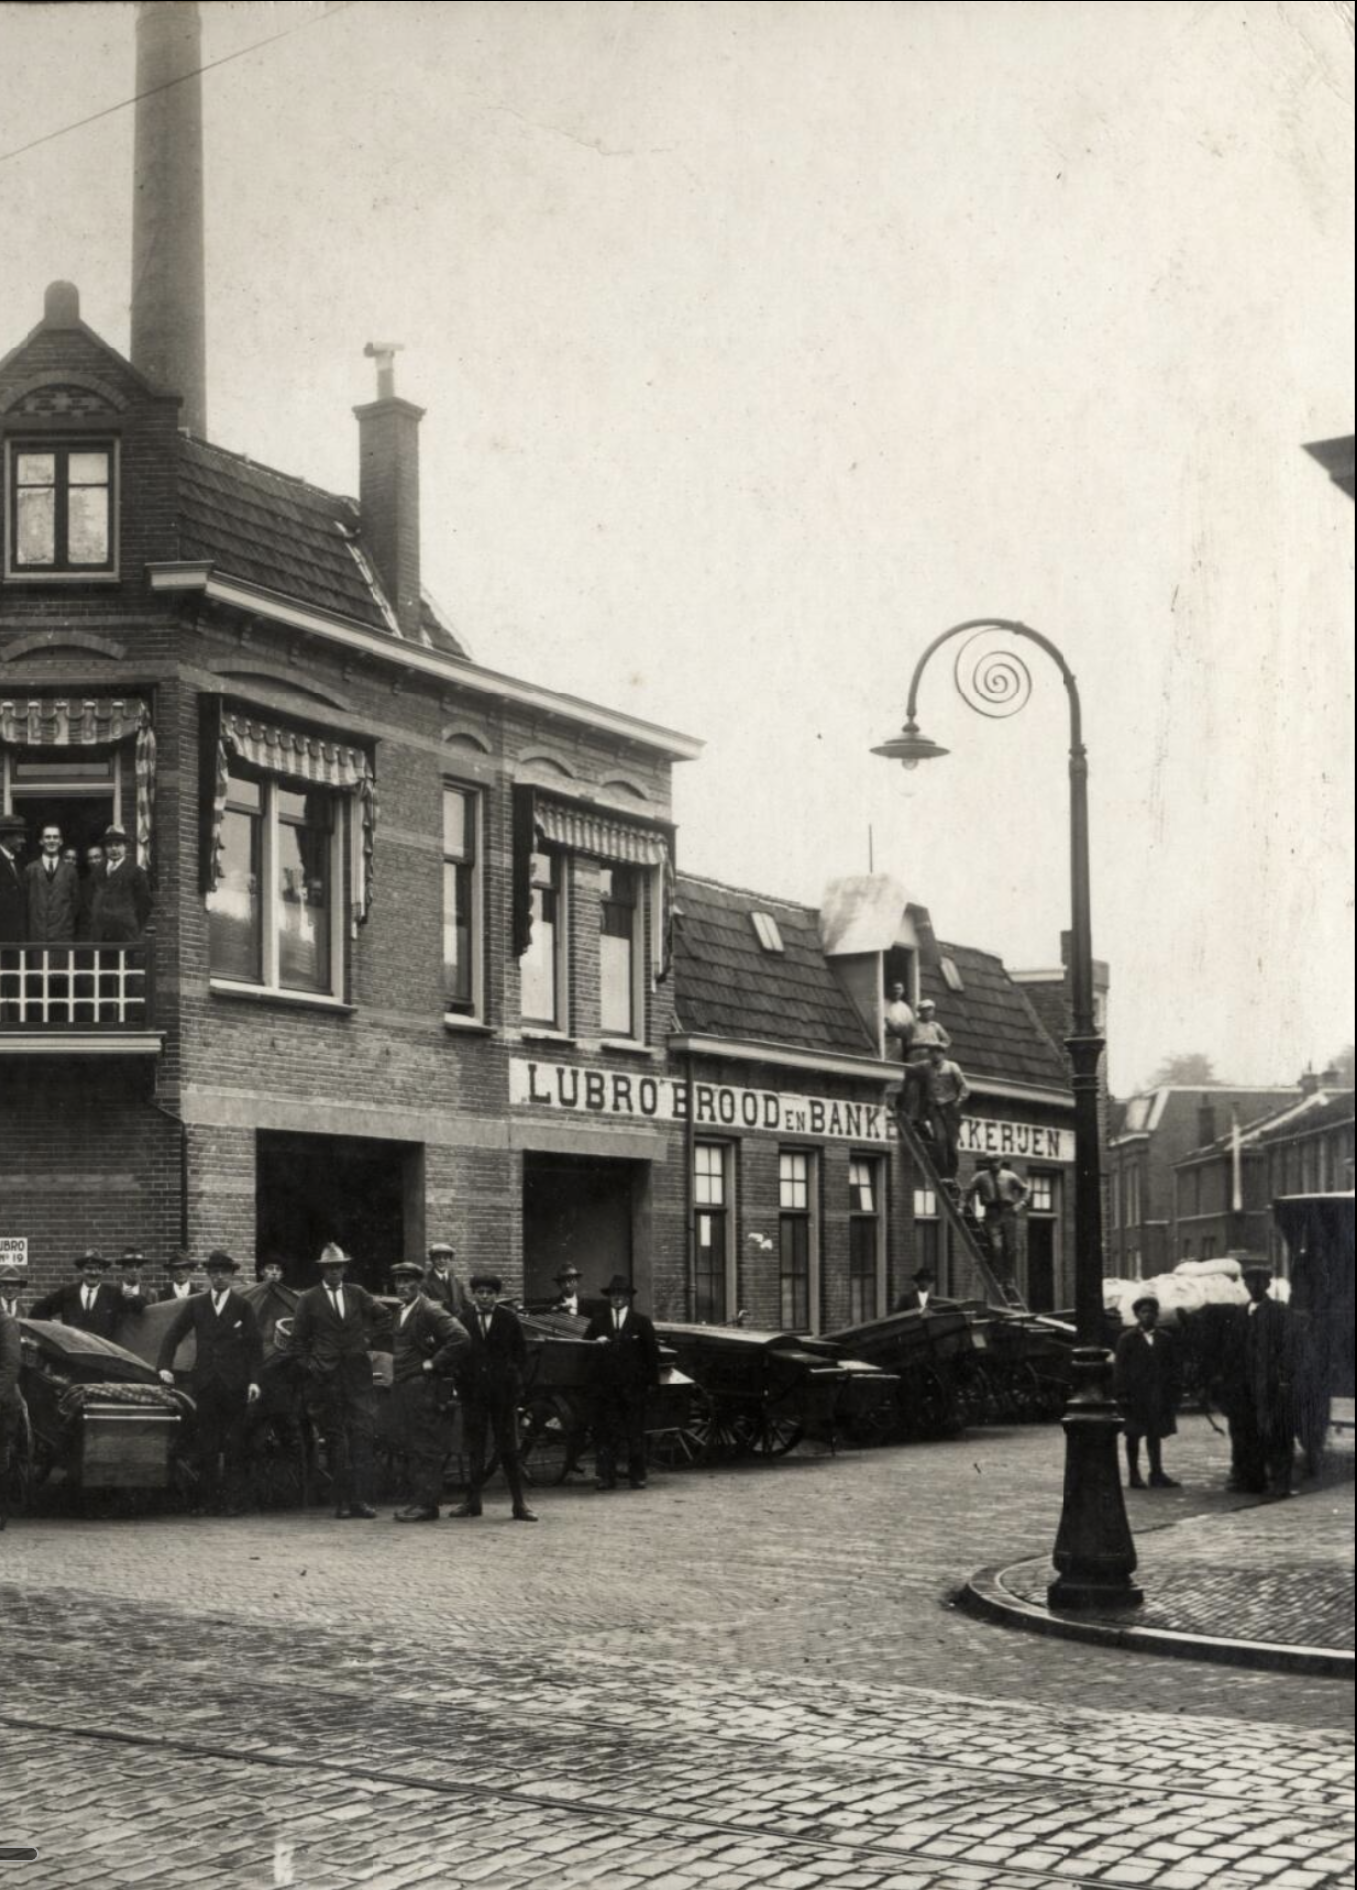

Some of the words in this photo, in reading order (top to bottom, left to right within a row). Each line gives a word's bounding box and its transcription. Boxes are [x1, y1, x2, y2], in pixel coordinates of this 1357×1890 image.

[672, 1082, 779, 1129] BROOD
[785, 1110, 805, 1132] EN
[809, 1100, 900, 1141] BANKE
